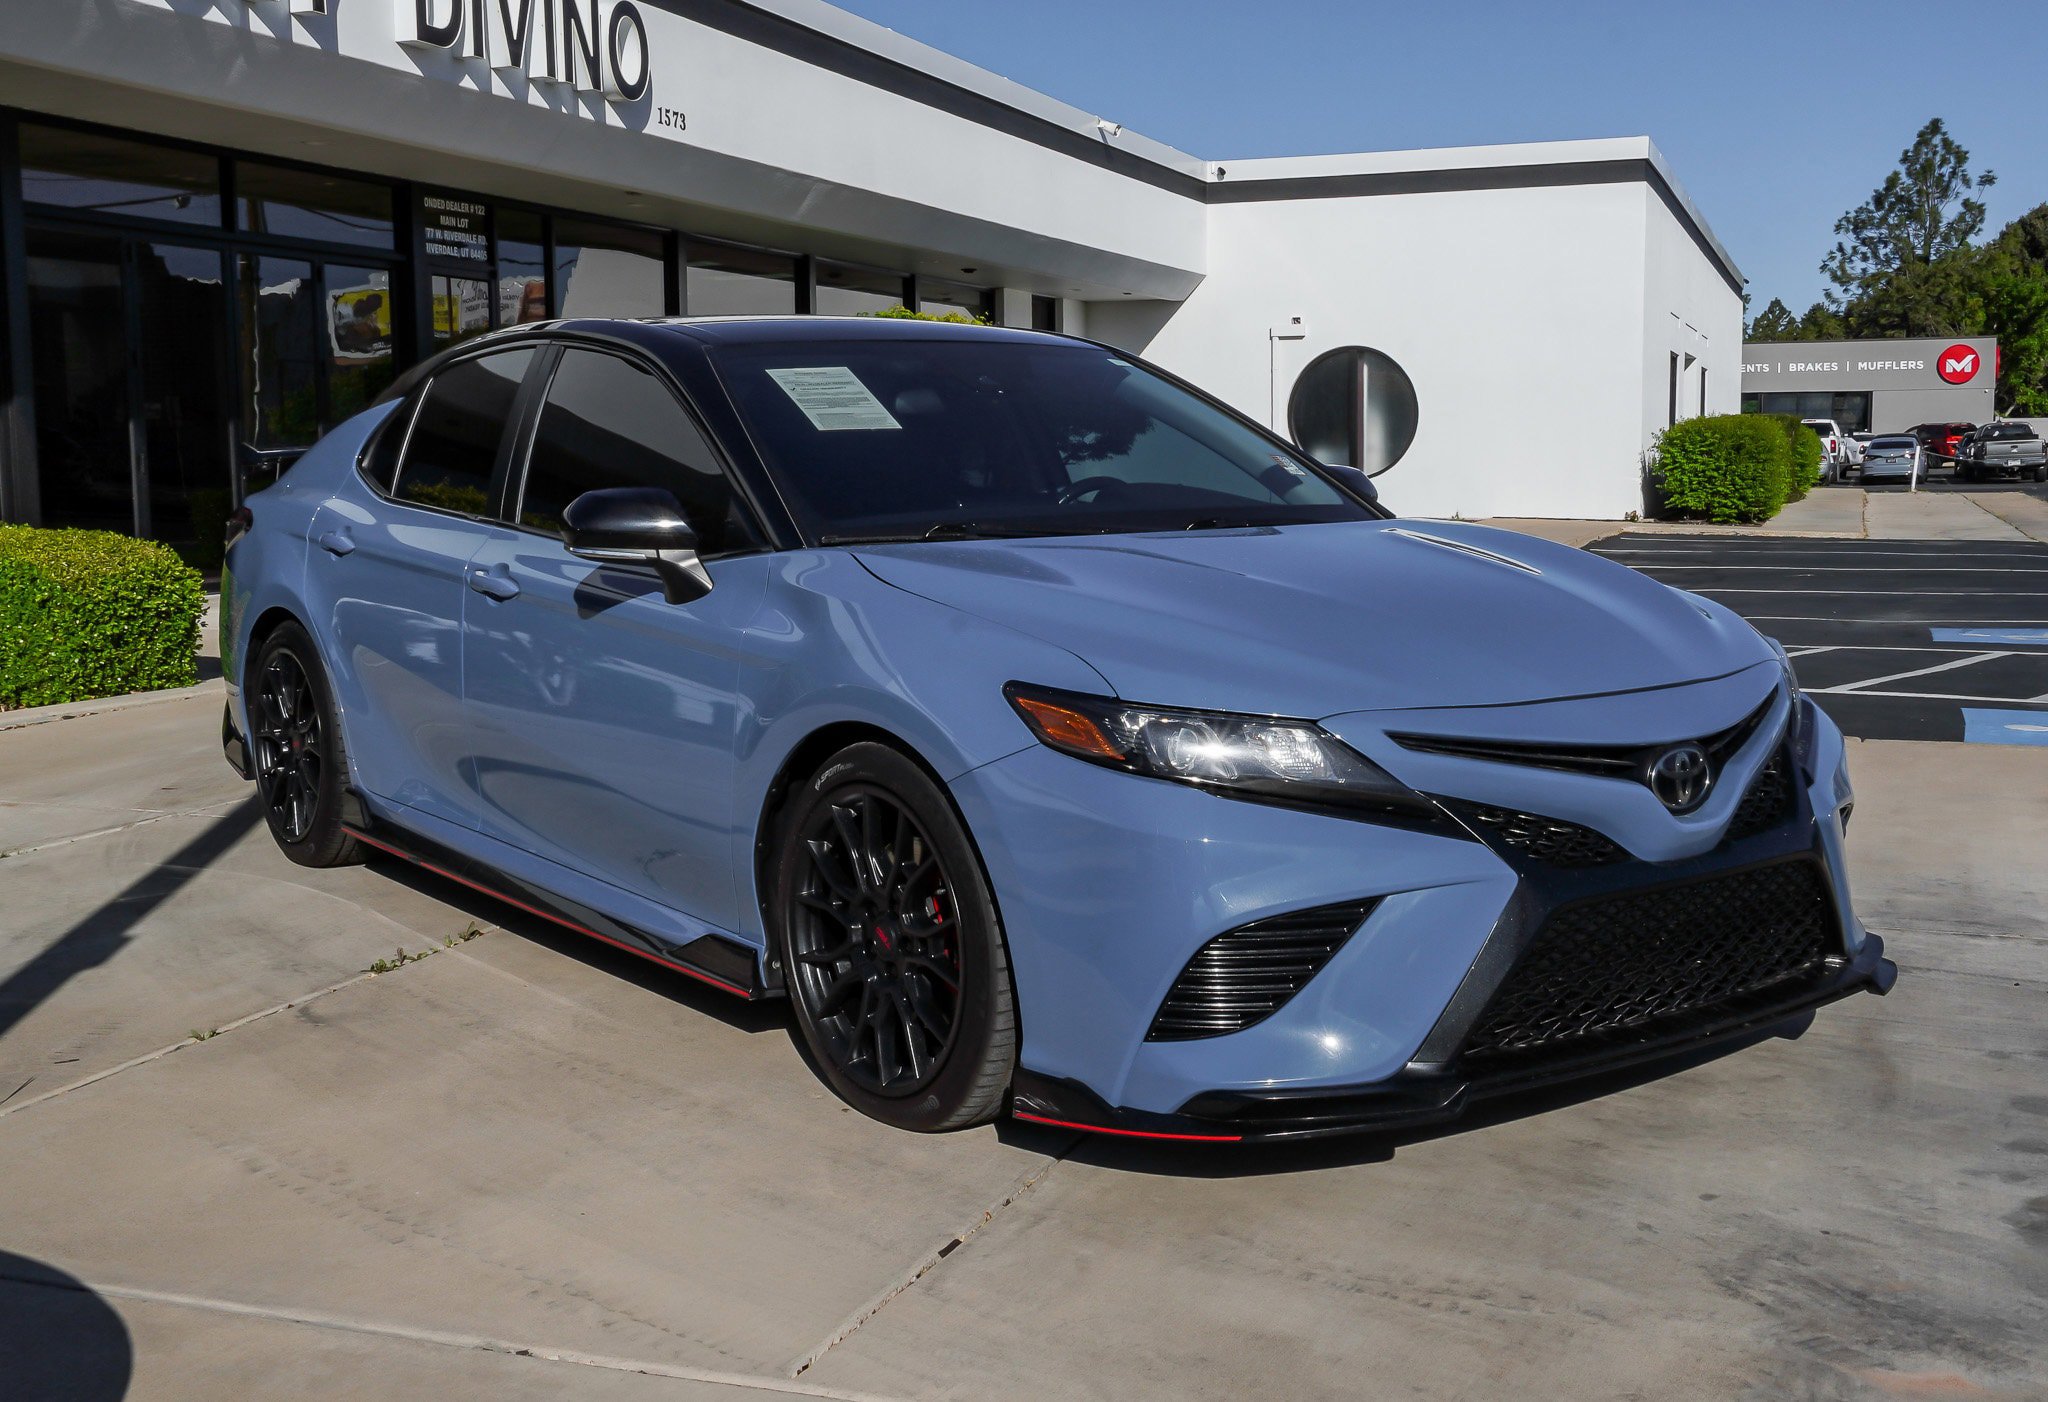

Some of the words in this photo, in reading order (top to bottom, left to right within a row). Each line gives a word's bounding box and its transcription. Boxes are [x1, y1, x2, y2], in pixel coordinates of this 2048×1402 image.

[656, 106, 687, 131] 1573
[445, 200, 469, 214] DEALER
[440, 215, 456, 227] MAIN
[457, 218, 469, 229] LOT
[444, 231, 477, 244] RIVERDALE
[460, 248, 469, 258] UT
[1740, 363, 1770, 373] ENTS
[1788, 362, 1839, 372] BRAKES
[1857, 360, 1924, 371] MUFFLERS
